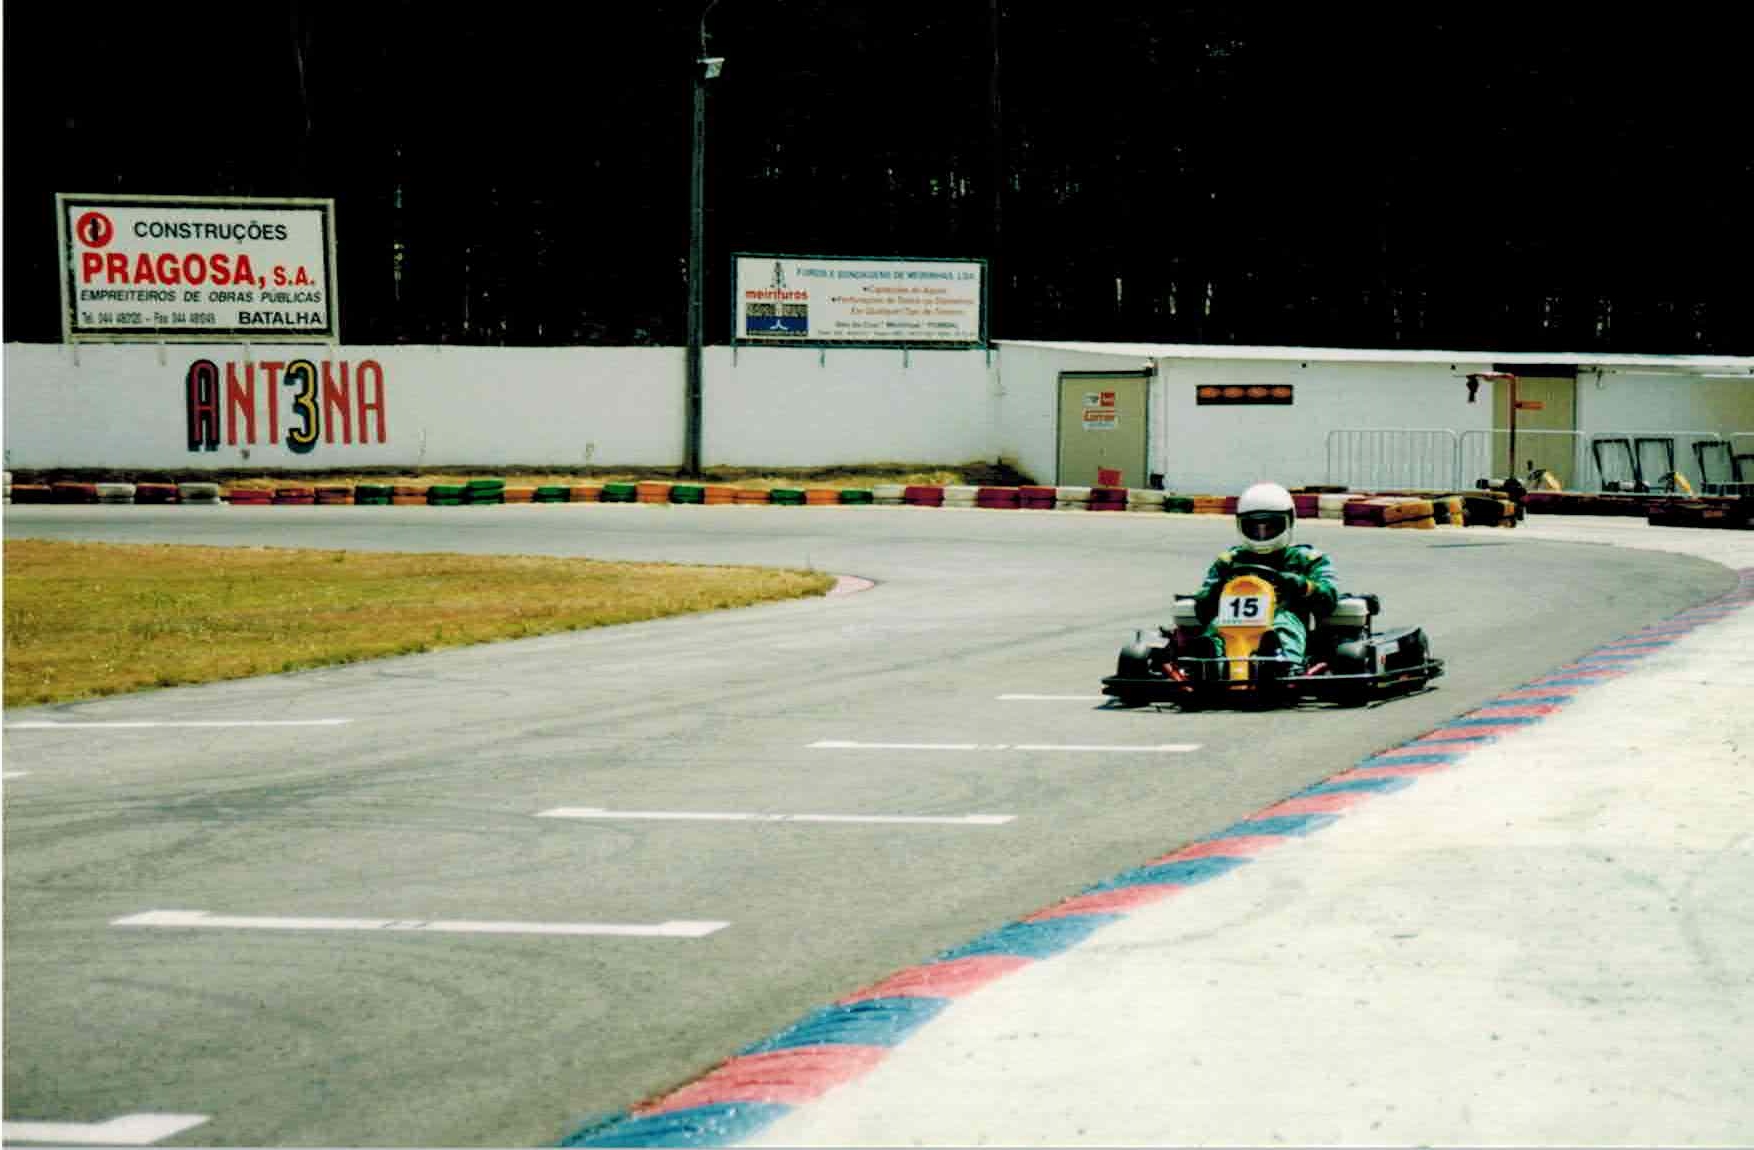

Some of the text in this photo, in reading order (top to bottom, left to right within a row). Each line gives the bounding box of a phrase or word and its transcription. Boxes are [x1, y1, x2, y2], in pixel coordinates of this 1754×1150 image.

[134, 220, 288, 244] CONSTRUÇÕES
[82, 252, 315, 290] PRAGOSA, S.A.
[80, 289, 176, 303] EMPREITEIROS
[183, 290, 202, 303] DE
[208, 291, 253, 303] OBRAS
[238, 311, 323, 325] BATALHA
[186, 359, 387, 454] ANT3NA
[1230, 598, 1259, 618] 15
